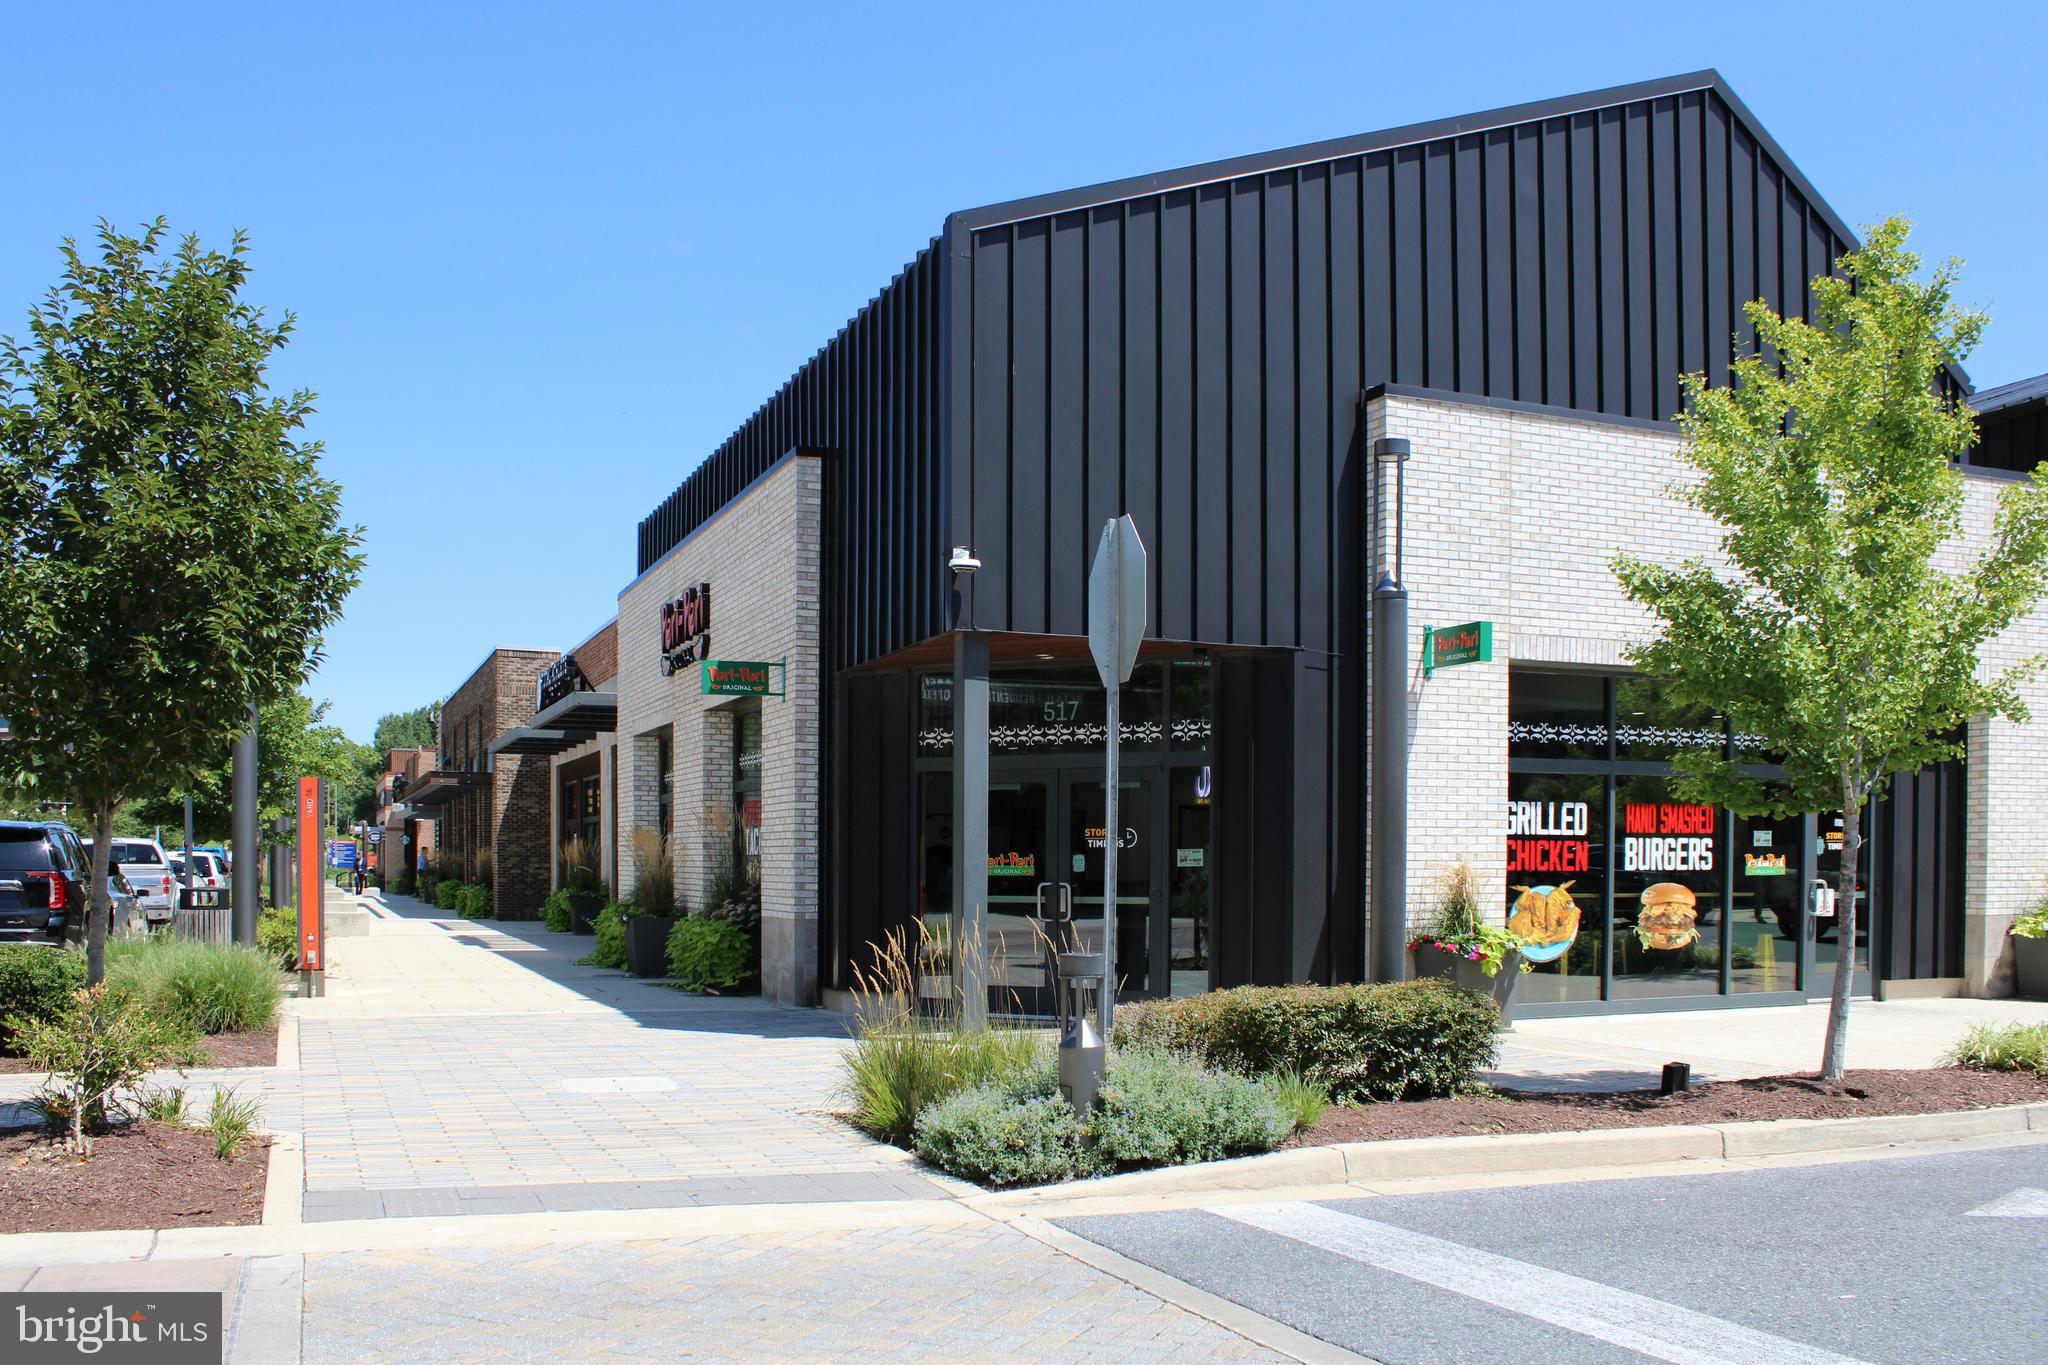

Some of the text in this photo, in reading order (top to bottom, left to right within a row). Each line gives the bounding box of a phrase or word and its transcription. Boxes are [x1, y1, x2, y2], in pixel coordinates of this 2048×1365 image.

[708, 665, 766, 683] Peri-Peri
[722, 684, 753, 692] ORIGINAL
[1043, 701, 1079, 721] 517
[1506, 801, 1588, 836] GRILLED
[1625, 803, 1715, 834] HAND SMASHED
[1084, 828, 1107, 837] STOR
[987, 851, 1035, 867] eri-Peri
[1506, 839, 1589, 872] CHICKEN
[1624, 837, 1713, 872] BURGERS
